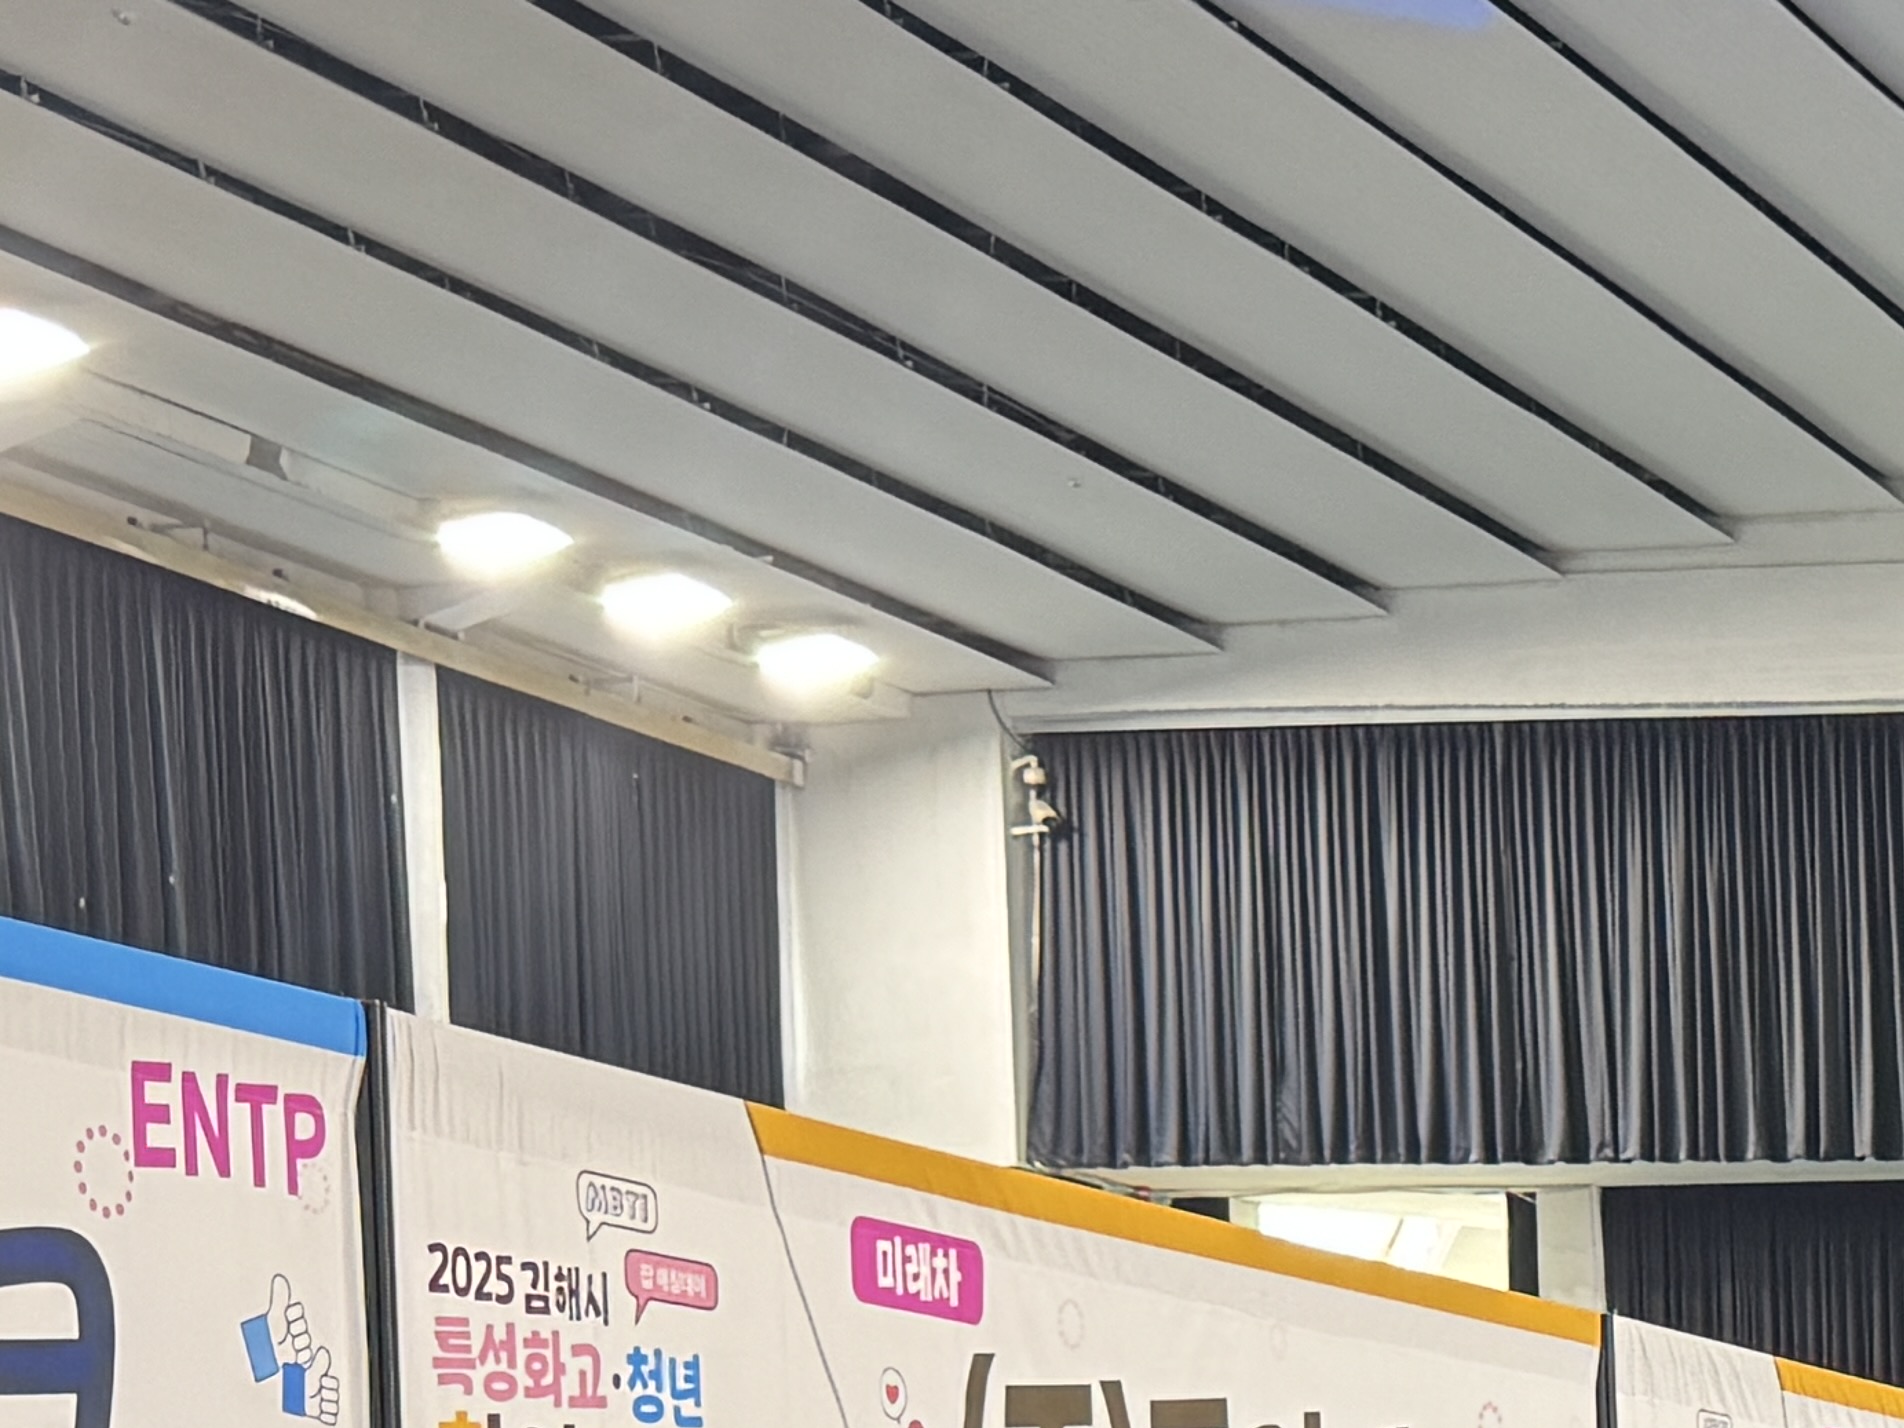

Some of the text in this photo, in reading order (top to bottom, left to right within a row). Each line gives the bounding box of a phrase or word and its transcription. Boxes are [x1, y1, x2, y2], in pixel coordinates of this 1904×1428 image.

[130, 1060, 327, 1198] ENTP
[586, 1181, 648, 1223] MBTI
[428, 1241, 611, 1326] 2025 김해시
[875, 1235, 962, 1307] 미래차
